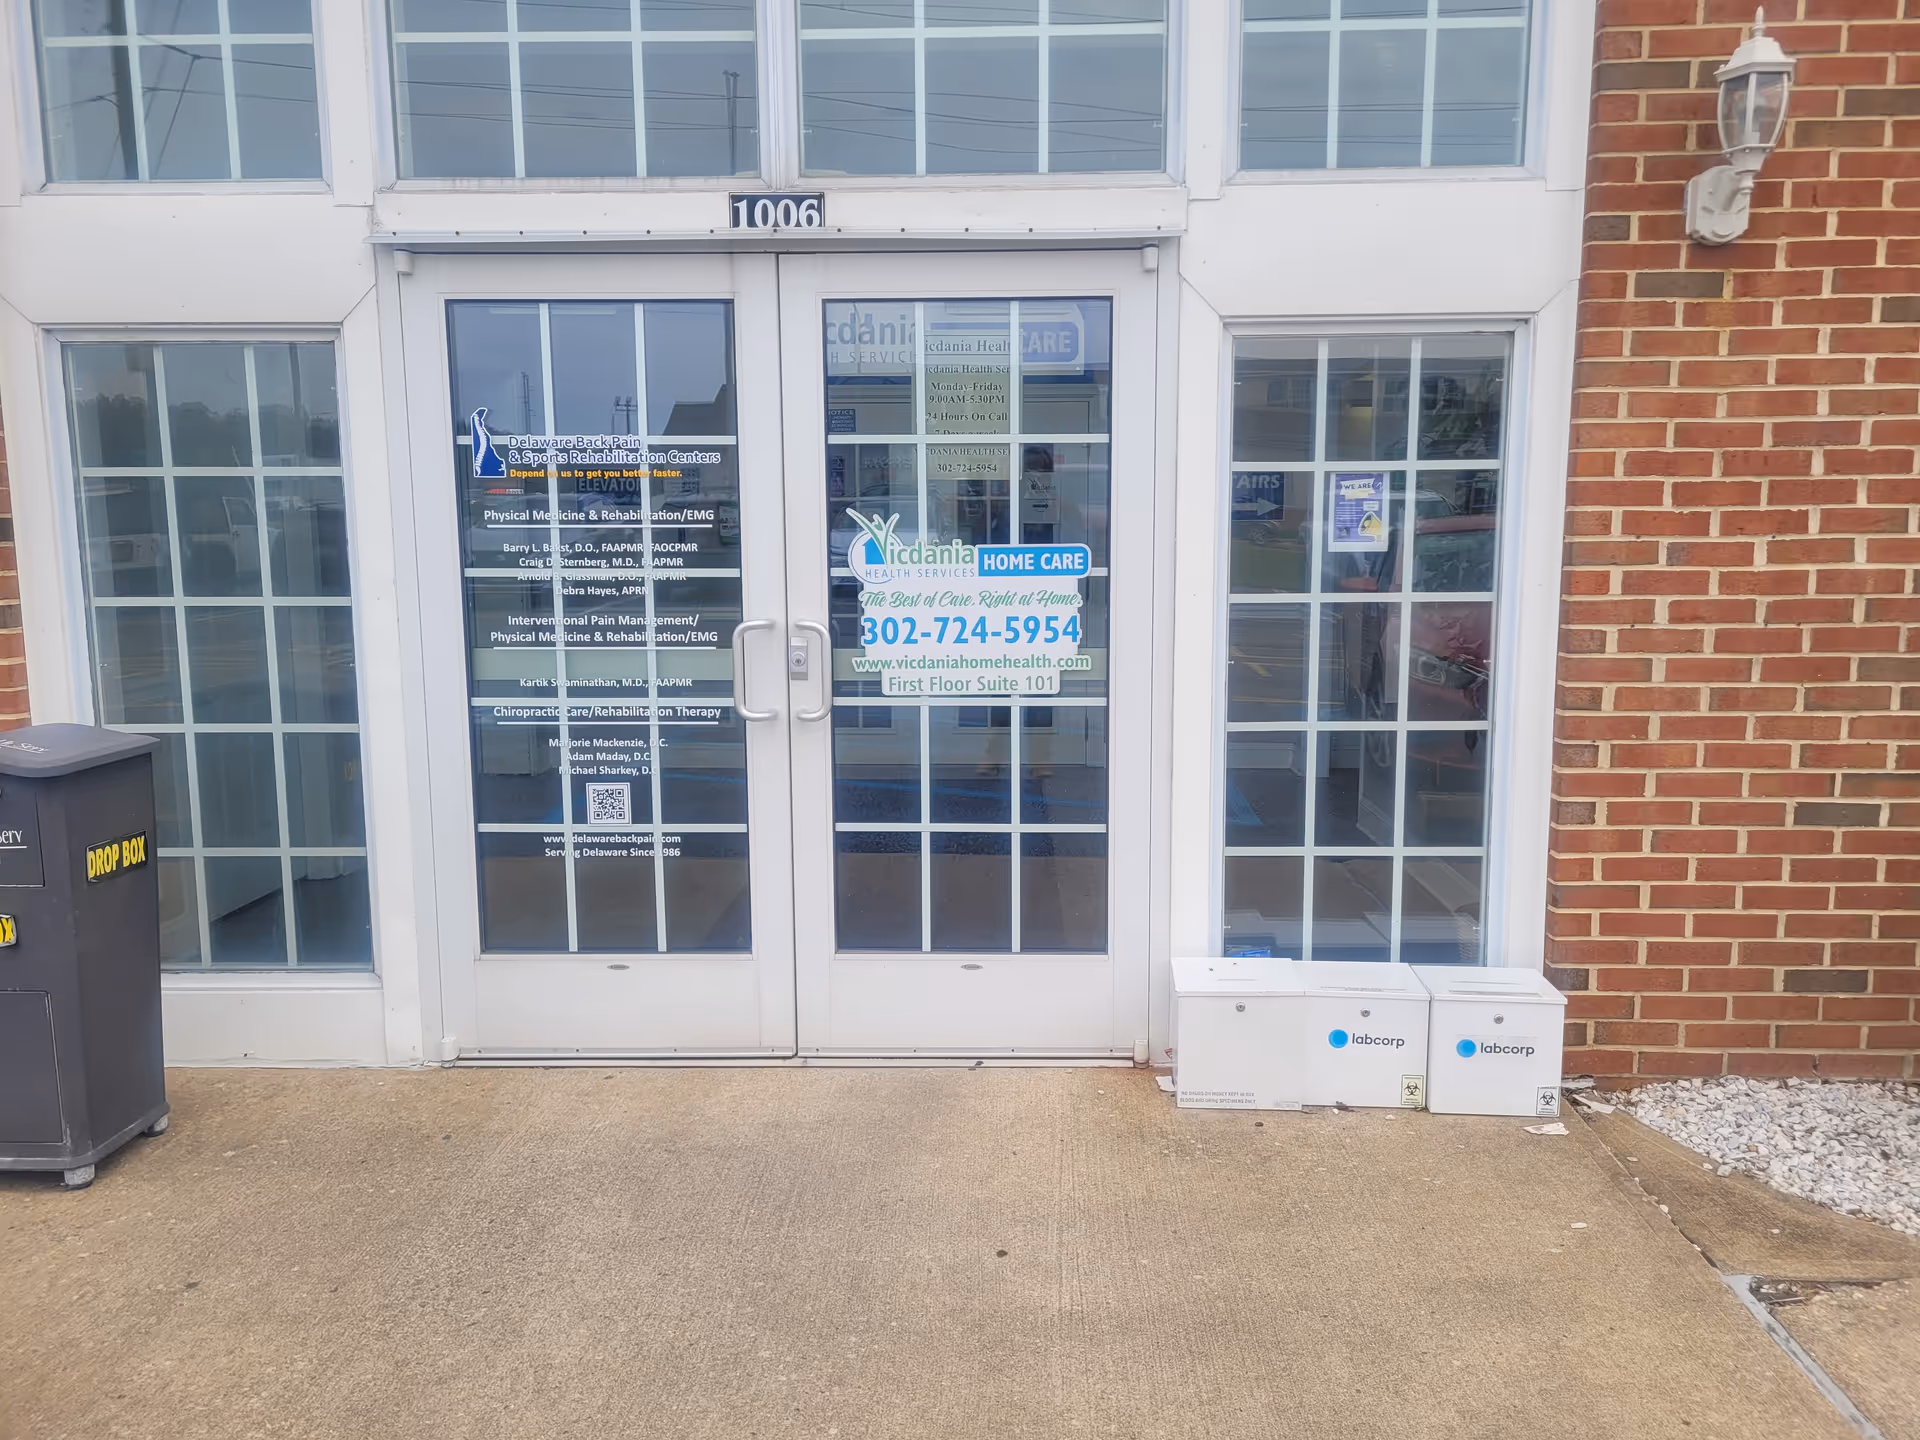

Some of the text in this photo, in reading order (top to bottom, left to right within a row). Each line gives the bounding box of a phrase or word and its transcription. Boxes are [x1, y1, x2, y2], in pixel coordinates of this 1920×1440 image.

[733, 198, 820, 228] 1006
[924, 340, 1010, 352] icdania Healt
[961, 364, 993, 374] Health
[930, 382, 1004, 393] Monday-Friday
[929, 395, 1005, 404] 9.00AM-5.30PM
[940, 412, 969, 421] Hours
[971, 412, 986, 421] On
[988, 412, 1008, 421] Call
[508, 434, 642, 449] Delaware Back Pain
[508, 450, 721, 467] & Sports Rehabilitation Centers
[960, 448, 996, 457] HEALTH
[510, 469, 545, 480] Depend
[560, 470, 572, 478] us
[574, 469, 584, 478] to
[586, 469, 601, 479] get
[603, 470, 621, 479] you
[622, 468, 651, 478] better
[652, 468, 683, 478] faster.
[936, 463, 998, 473] 302-724-5954
[484, 508, 715, 522] Physical Medicine & Rehabilitation/EMG
[503, 543, 698, 554] Barry L. Bakst, D.O., FAAPMR FAOCPMR
[518, 557, 544, 568] Craig
[559, 557, 610, 568] Sternberg,
[612, 557, 639, 568] M.D.,
[641, 557, 684, 567] FAAPMR
[983, 553, 1035, 571] HOME
[1040, 552, 1084, 570] CARE
[517, 571, 551, 581] Arnold
[865, 568, 975, 578] HEALTH SERVICES
[555, 585, 649, 597] Debra Hayes, APRN
[861, 589, 1081, 609] The Best of Care, Right at Home.
[508, 613, 699, 627] Interventional Pain Management/
[863, 615, 1080, 645] 302-724-5954
[490, 630, 718, 644] Physical Medicine & Rehabilitation/EMG
[854, 653, 1089, 670] www.vicdaniahomehealth.com
[520, 677, 693, 689] Kartik Swaminathan, M.D., FAAPMR
[888, 676, 1054, 692] First Floor Suite 101
[493, 705, 722, 719] Chiropractic Care/Rehabilitation Therapy
[548, 738, 591, 749] Marjorie
[593, 738, 647, 749] Mackenzie,
[565, 752, 594, 761] Adam
[596, 752, 631, 762] Maday,
[558, 765, 657, 776] Michael Sharkey, D.C
[543, 834, 681, 845] www.delawarebackpain.com
[88, 835, 146, 878] DROP BOX
[545, 847, 681, 858] Serving Delaware Since 1986
[1352, 1033, 1405, 1049] labcorp
[1480, 1043, 1535, 1057] labcorp
